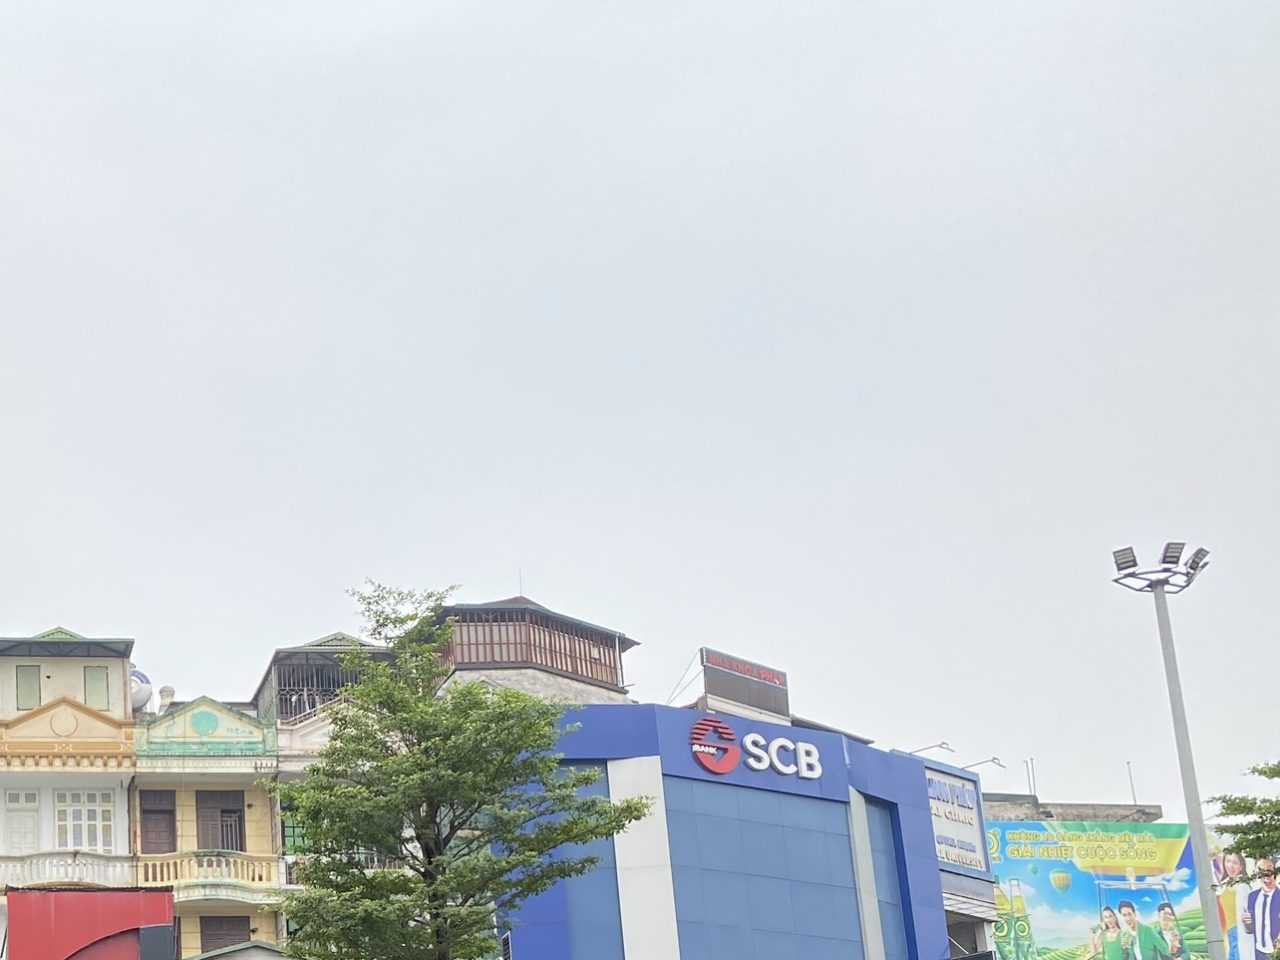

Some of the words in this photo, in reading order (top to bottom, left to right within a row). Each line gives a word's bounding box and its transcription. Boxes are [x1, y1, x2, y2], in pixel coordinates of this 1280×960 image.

[742, 732, 823, 779] SCB
[1039, 843, 1073, 860] NHIỆT
[1077, 844, 1117, 862] CUỘC
[1119, 842, 1157, 861] SỐNG
